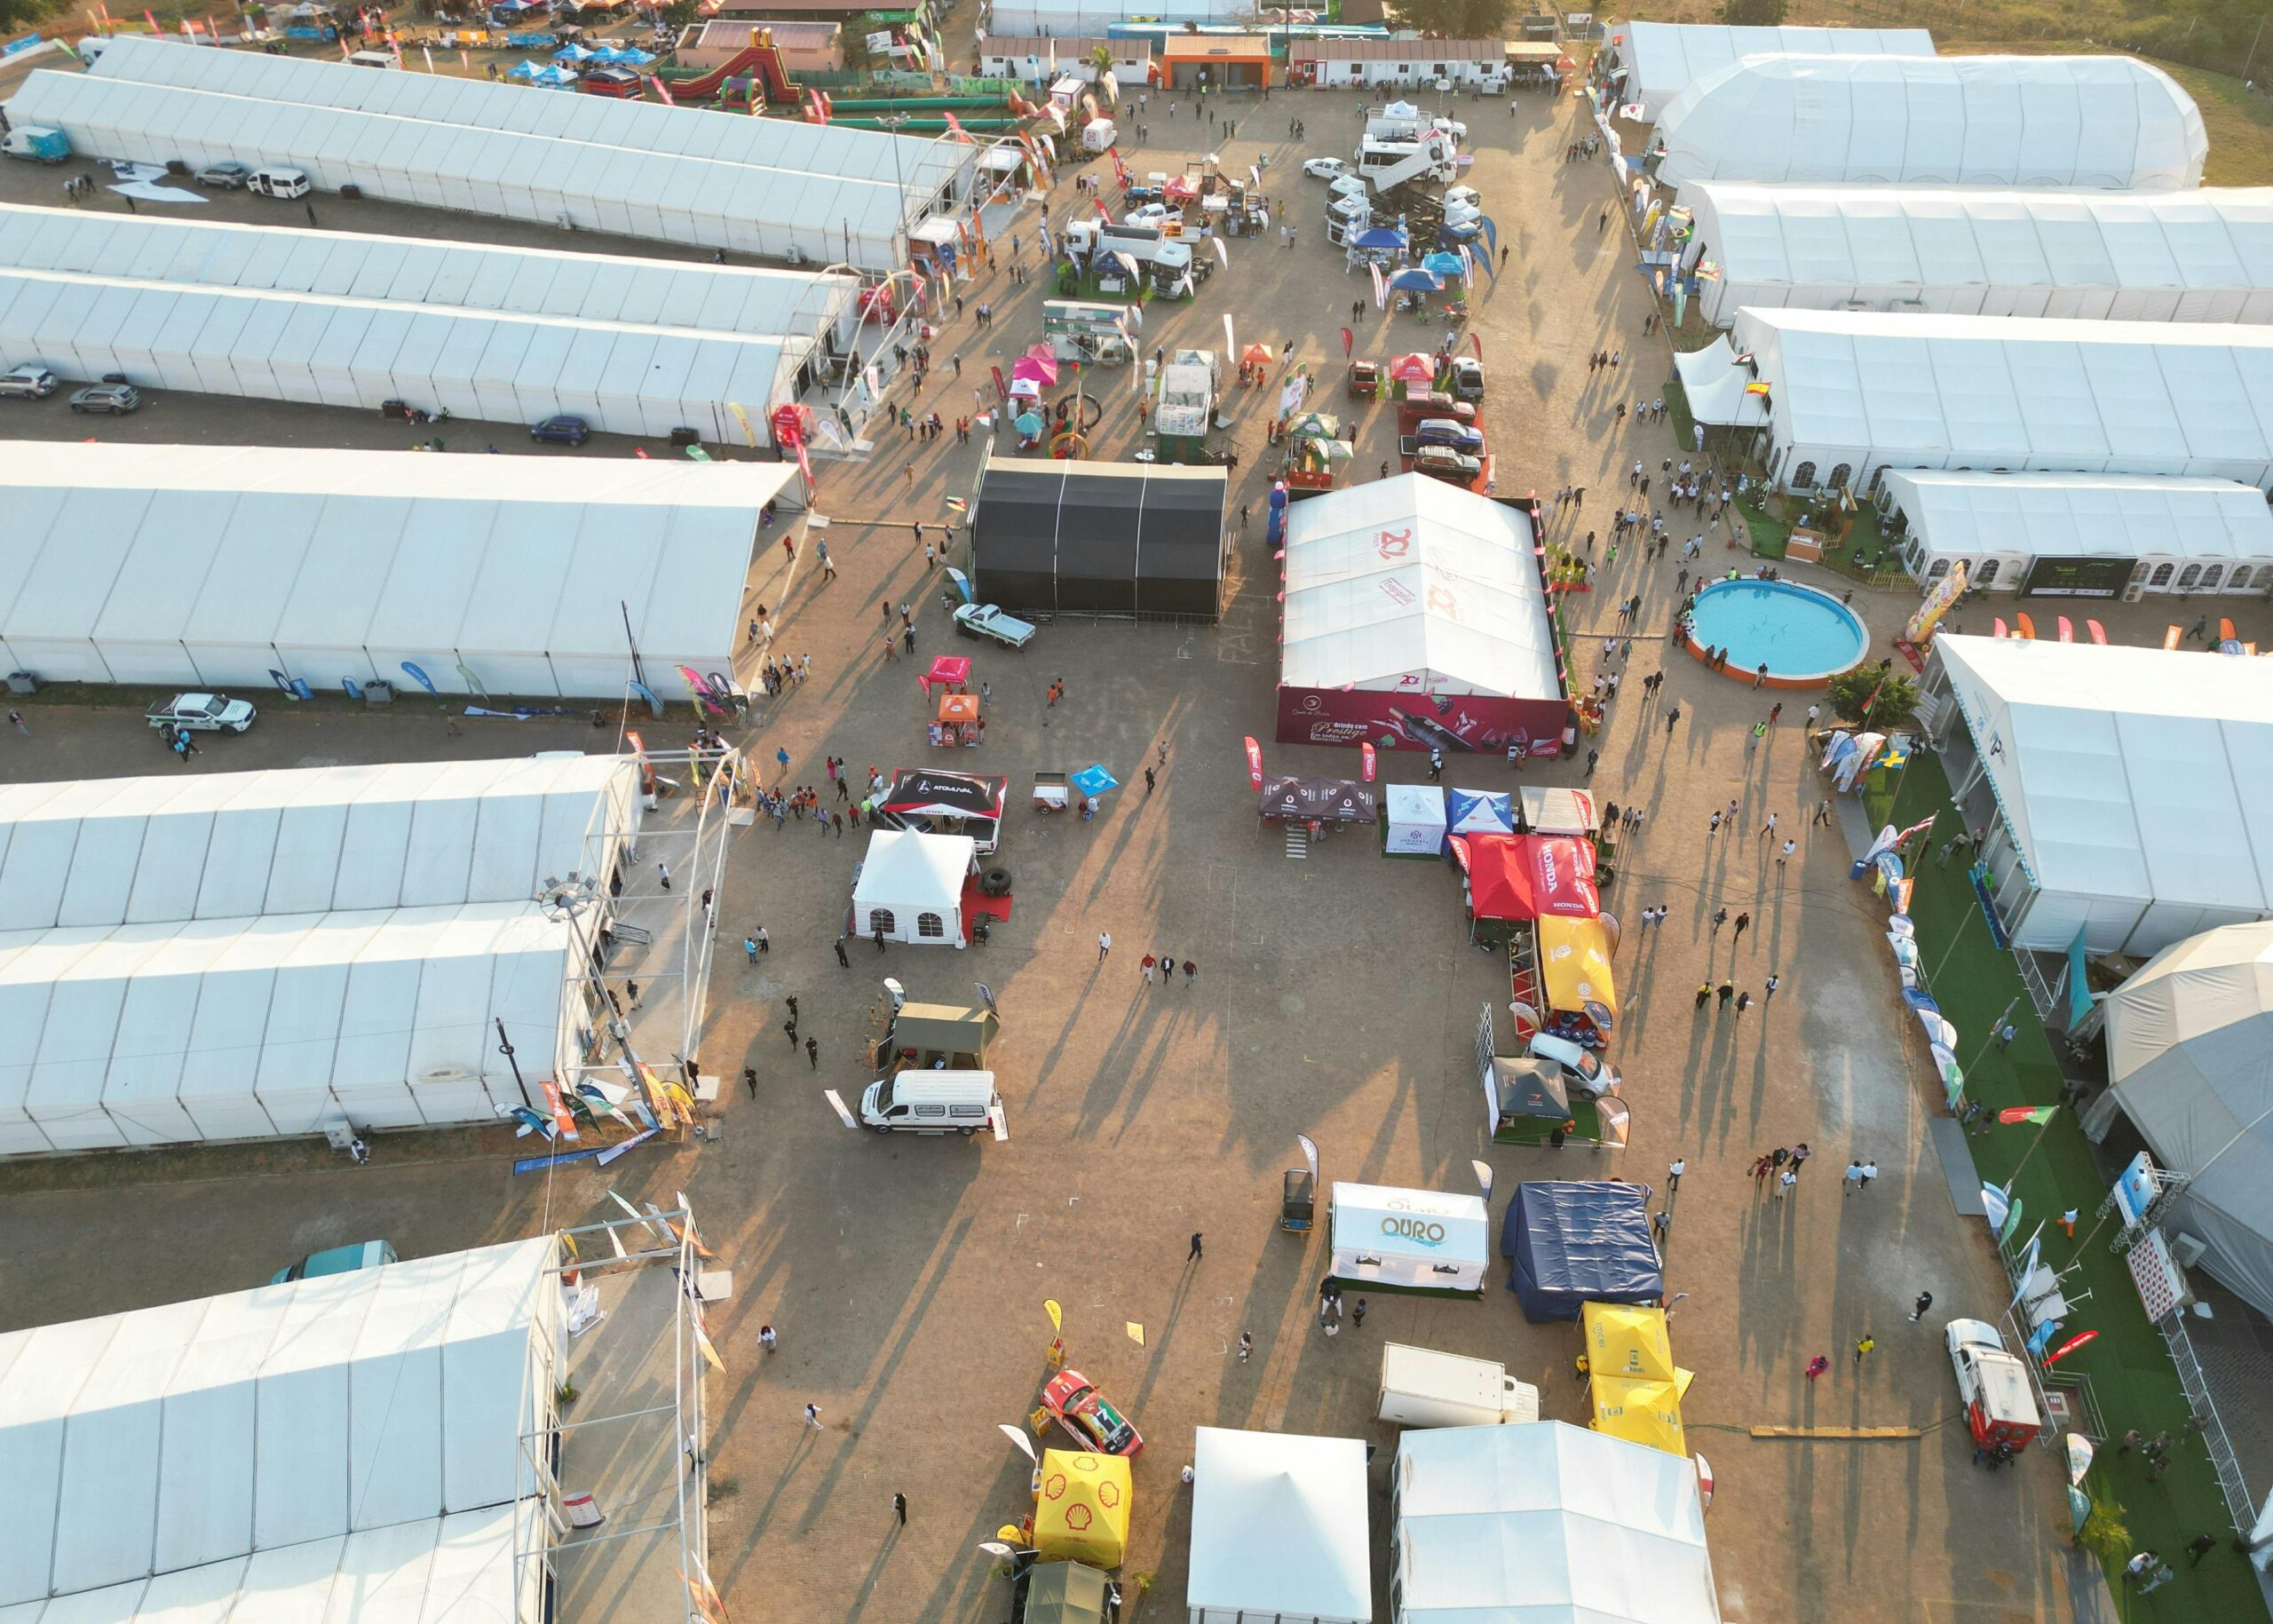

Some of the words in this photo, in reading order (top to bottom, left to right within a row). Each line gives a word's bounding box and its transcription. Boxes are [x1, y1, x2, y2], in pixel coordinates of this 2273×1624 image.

[933, 785, 973, 795] ATOMUVAL
[1541, 844, 1558, 894] HONDA
[1381, 1216, 1445, 1242] OURO
